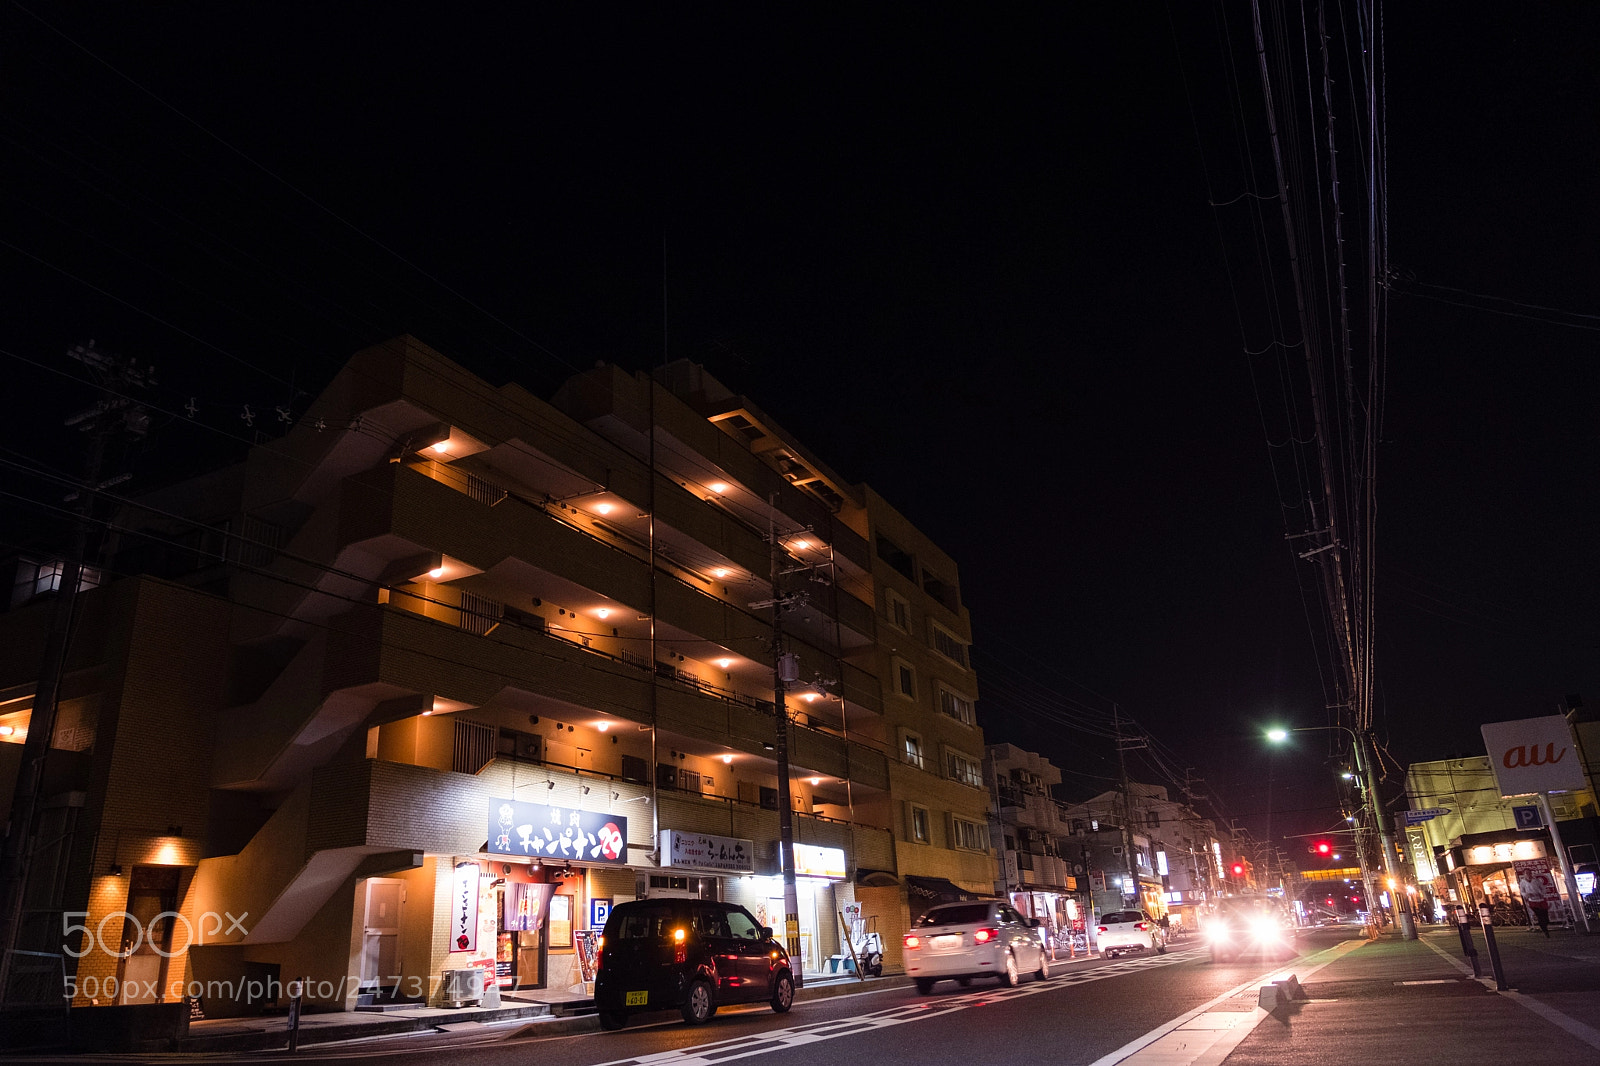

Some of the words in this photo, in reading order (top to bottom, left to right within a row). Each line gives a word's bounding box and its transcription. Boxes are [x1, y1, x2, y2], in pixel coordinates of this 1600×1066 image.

[1503, 742, 1566, 769] au
[550, 807, 580, 828] 焼肉
[1520, 810, 1534, 825] P
[597, 906, 606, 922] P
